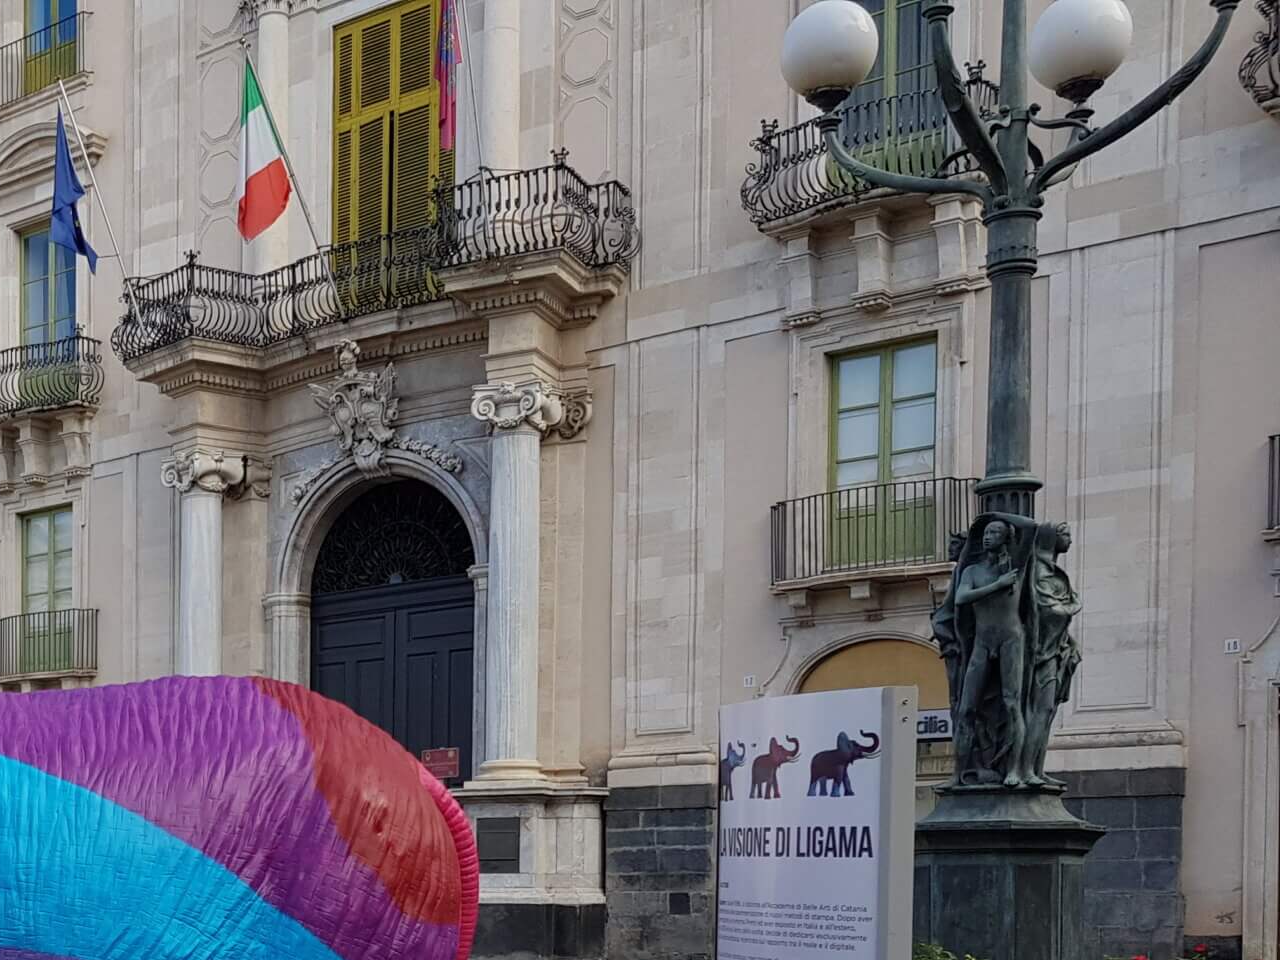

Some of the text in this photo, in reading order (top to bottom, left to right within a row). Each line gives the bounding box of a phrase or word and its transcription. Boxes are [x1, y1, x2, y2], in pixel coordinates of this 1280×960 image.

[728, 827, 771, 857] VISIONE
[775, 826, 791, 857] DI
[796, 825, 874, 858] LIGAMA
[841, 905, 868, 913] Catania
